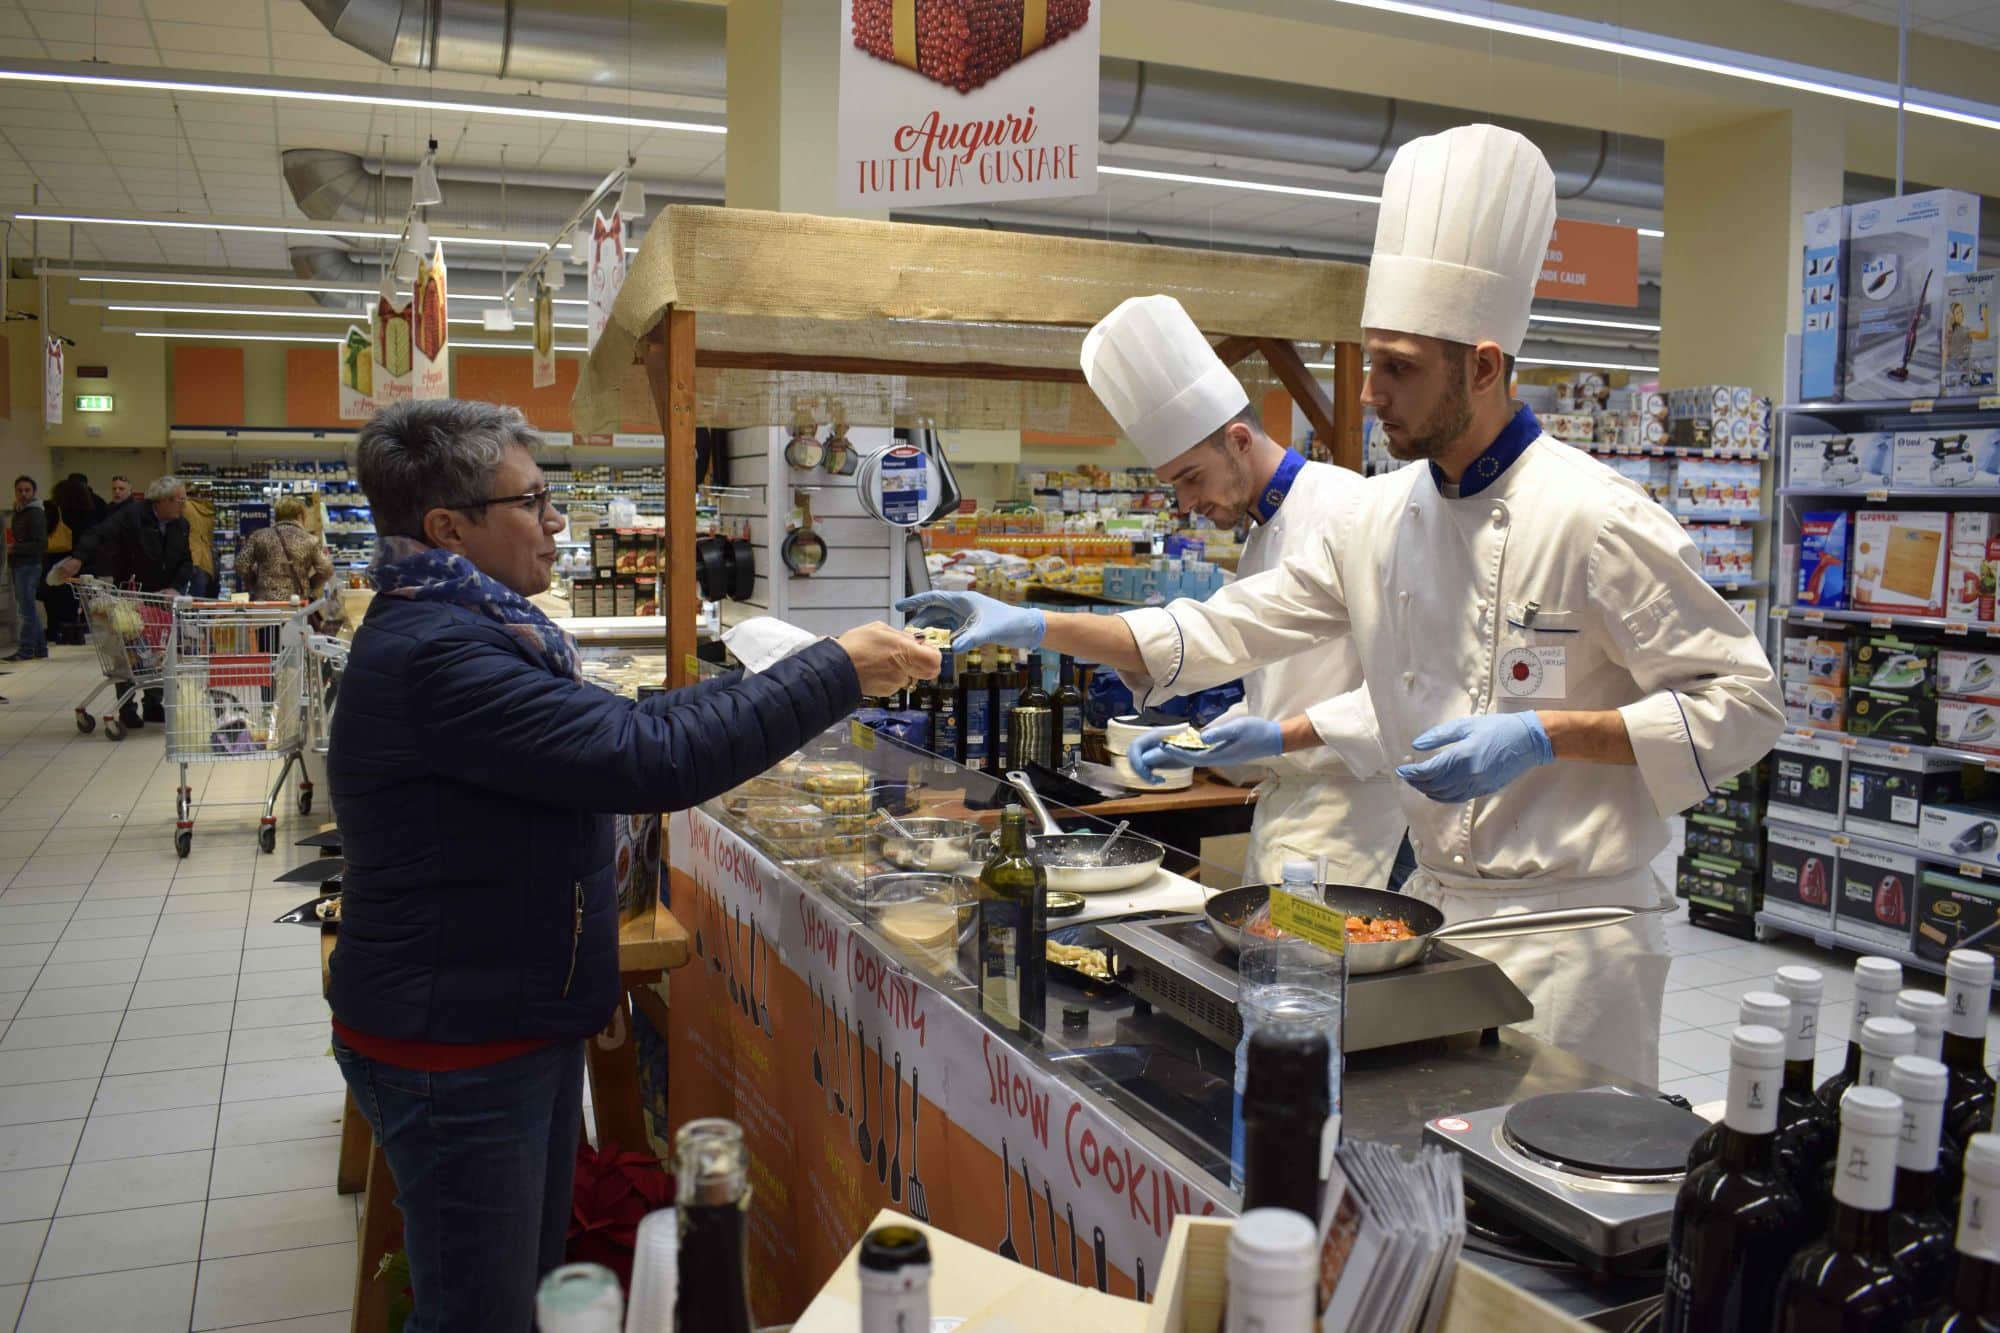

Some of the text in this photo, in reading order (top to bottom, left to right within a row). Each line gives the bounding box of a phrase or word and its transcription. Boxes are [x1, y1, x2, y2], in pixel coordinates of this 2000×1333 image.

[856, 144, 1080, 194] TUTTI DA GUSTARE
[894, 105, 1038, 173] Auguri
[687, 808, 762, 905] SHOW COOKING
[800, 892, 926, 1049] SHOW COOKING
[983, 1033, 1216, 1238] SHOW COOKIN
